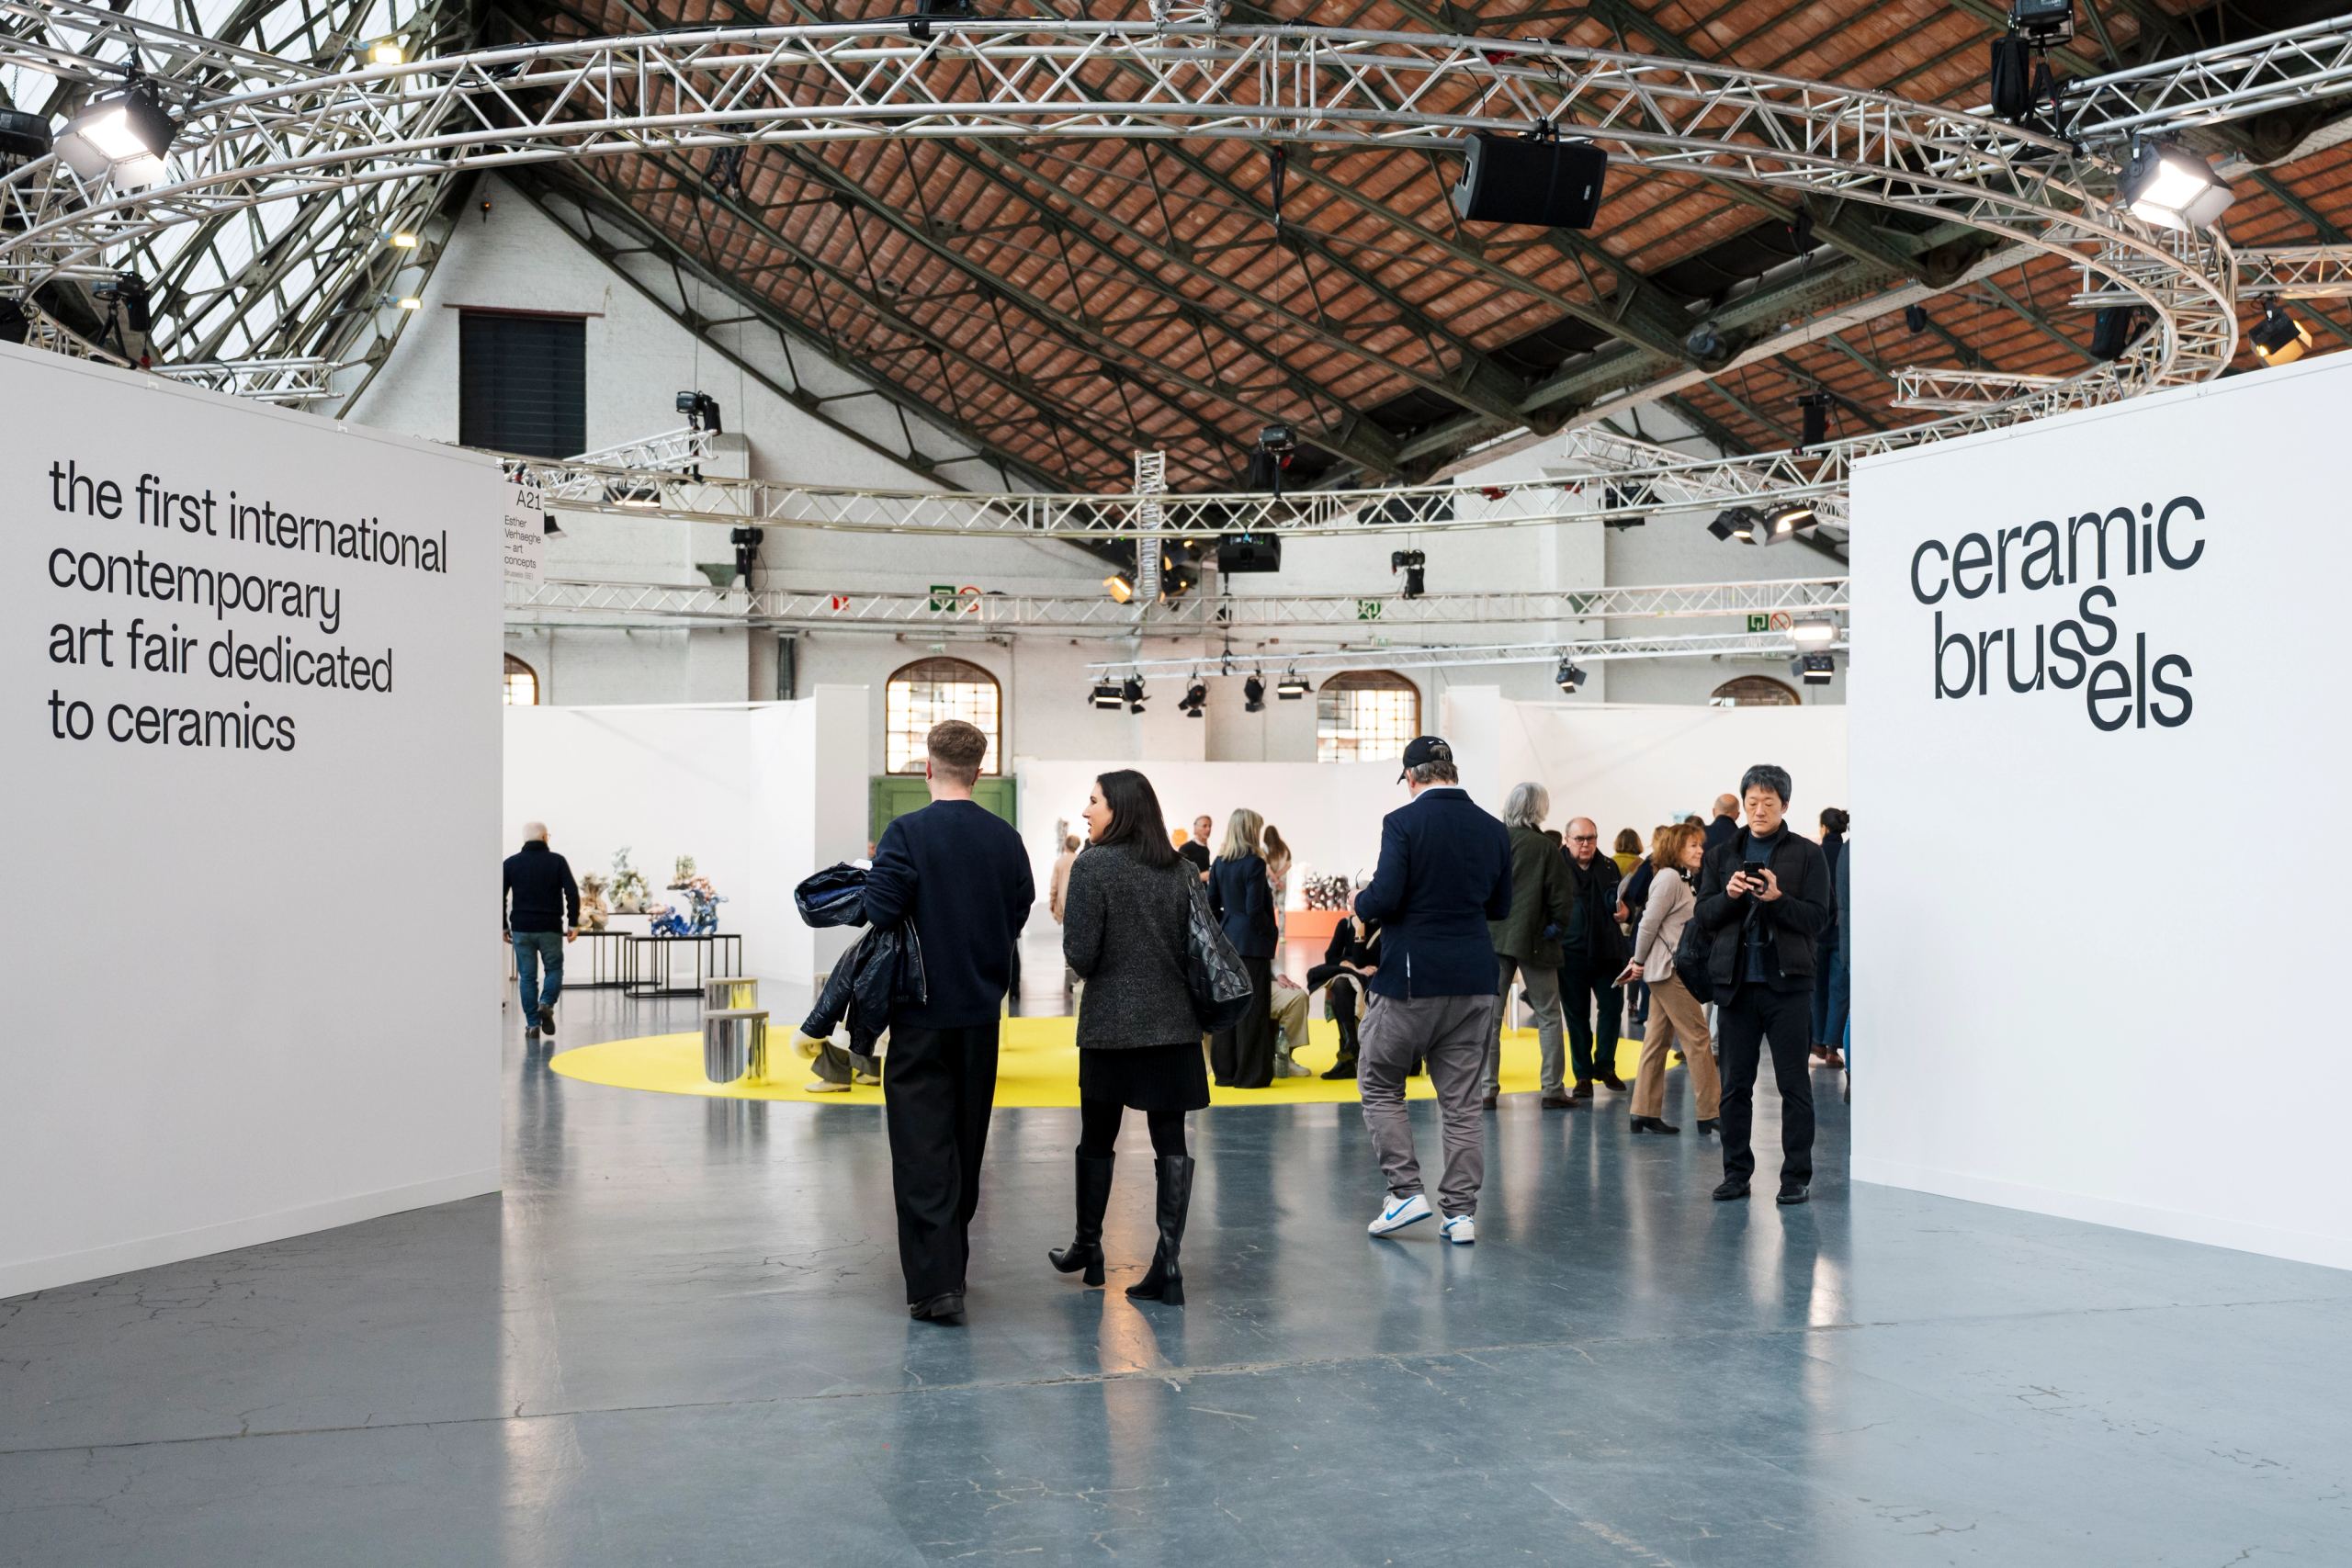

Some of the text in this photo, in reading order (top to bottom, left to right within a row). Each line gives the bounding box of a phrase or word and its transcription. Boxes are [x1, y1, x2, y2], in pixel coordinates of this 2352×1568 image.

[49, 460, 447, 573] the first international
[516, 490, 542, 511] A21
[504, 515, 527, 528] Esther
[504, 528, 542, 545] Verhaeghe
[504, 556, 537, 570] concepts
[513, 545, 524, 554] art
[1911, 496, 2206, 605] ceramic
[49, 547, 341, 634] contemporary
[49, 618, 392, 693] art fair dedicated
[48, 689, 296, 751] to ceramics
